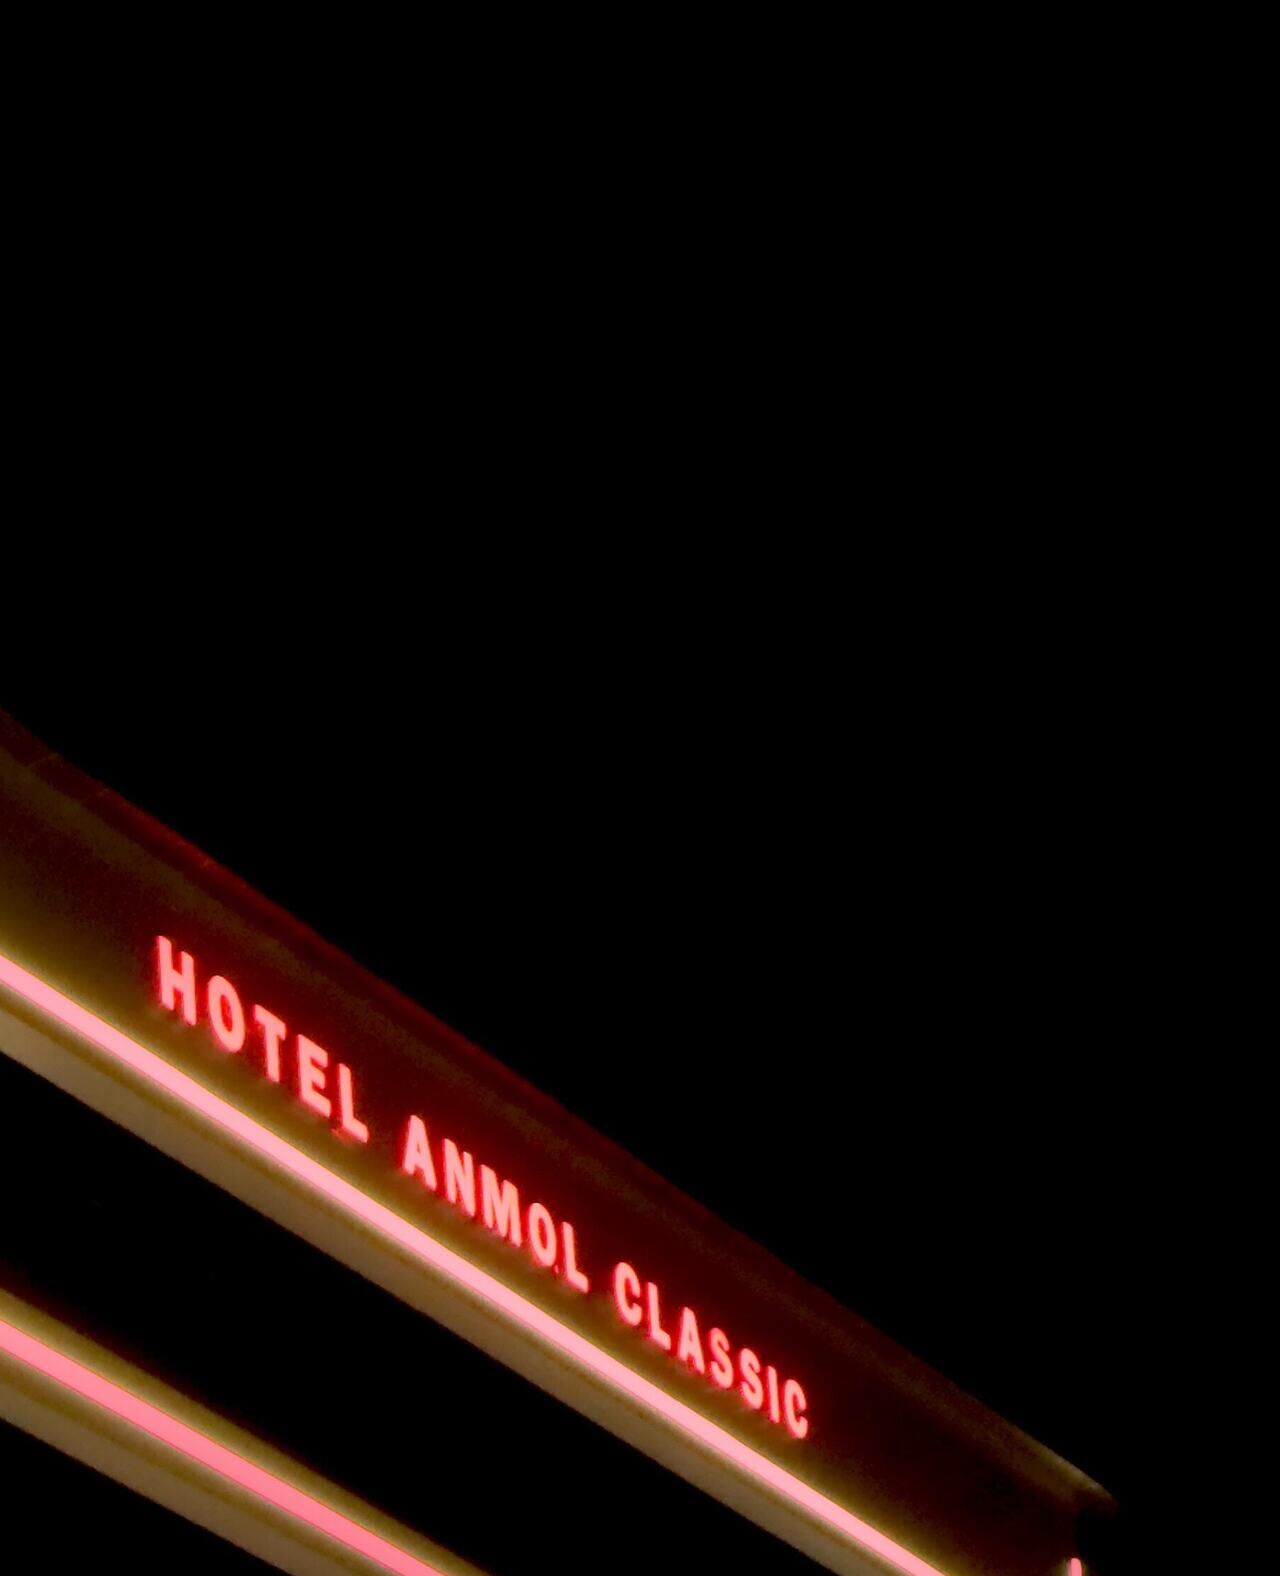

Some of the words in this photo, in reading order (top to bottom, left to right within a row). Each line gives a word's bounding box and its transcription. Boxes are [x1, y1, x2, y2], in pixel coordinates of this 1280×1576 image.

[156, 935, 369, 1144] HOTEL
[401, 1115, 590, 1294] ANMOL
[613, 1262, 809, 1441] CLASSIC
